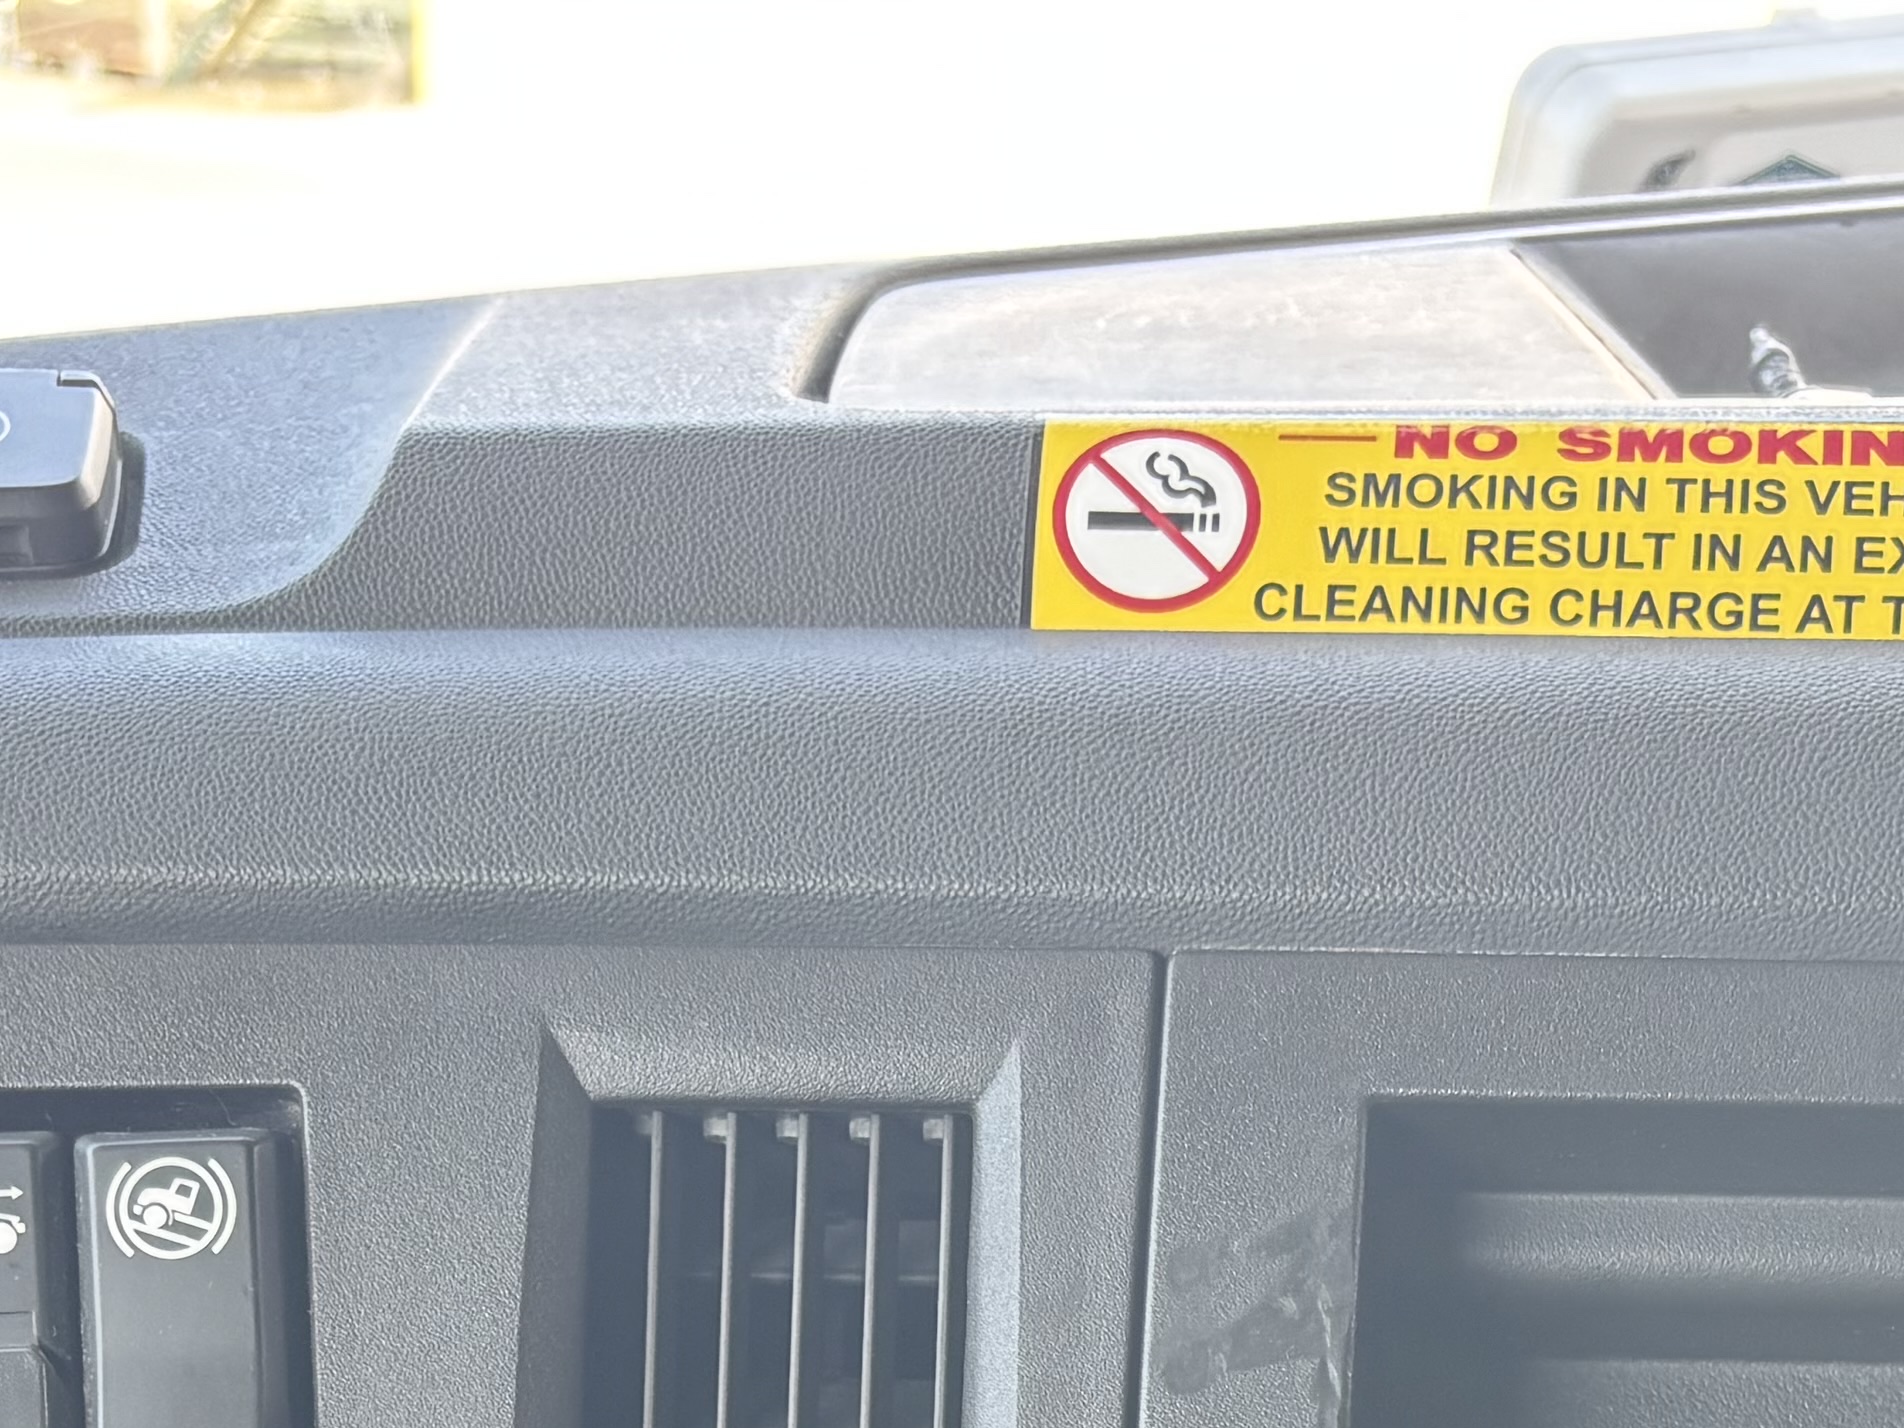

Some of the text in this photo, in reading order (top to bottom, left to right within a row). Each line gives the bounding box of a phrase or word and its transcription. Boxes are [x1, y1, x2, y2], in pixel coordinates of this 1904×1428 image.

[1394, 424, 1518, 461] NO
[1324, 471, 1578, 512] SMOKING
[1596, 476, 1648, 512] IN
[1665, 478, 1787, 515] THIS
[1318, 526, 1447, 566] WILL
[1464, 529, 1676, 571] RESULT
[1691, 533, 1742, 572] IN
[1756, 535, 1834, 574] AN
[1253, 582, 1530, 626] CLEANING
[1548, 587, 1781, 632] CHARGE
[1795, 593, 1866, 634] AT
